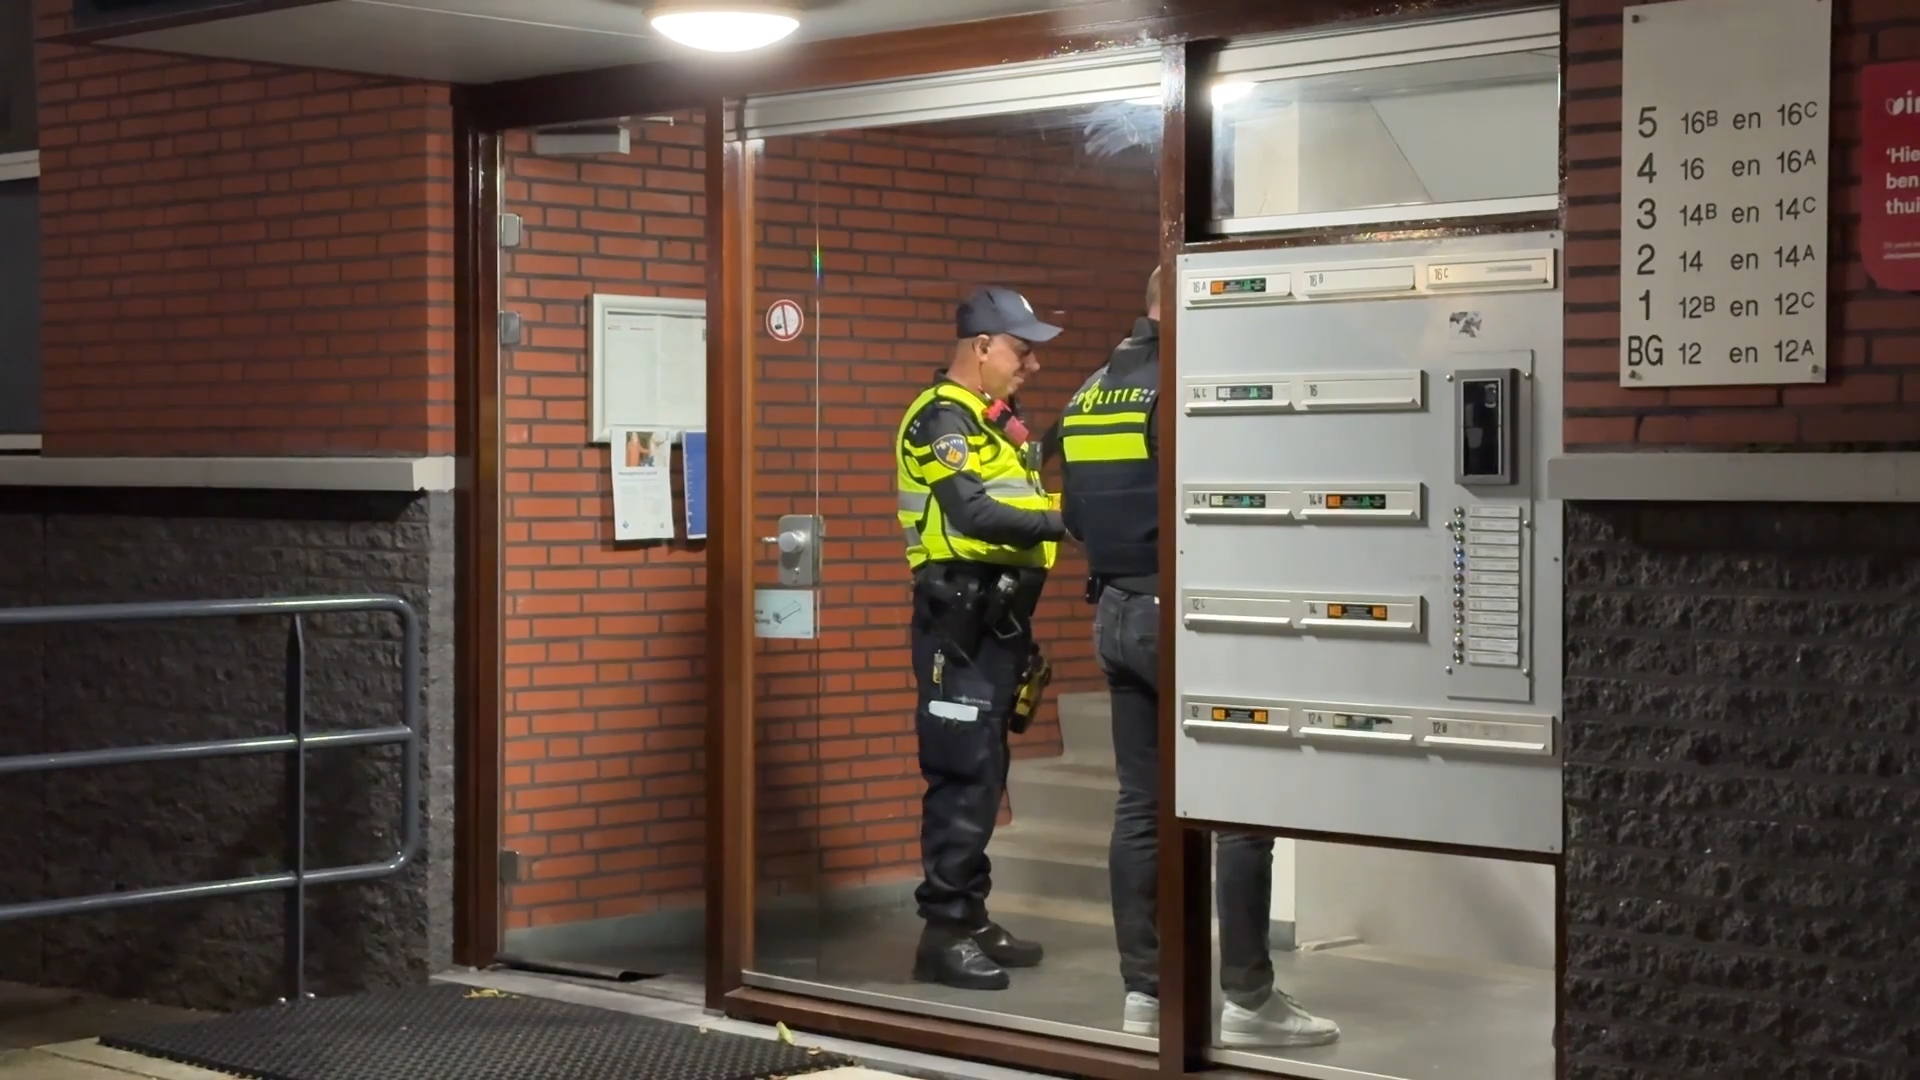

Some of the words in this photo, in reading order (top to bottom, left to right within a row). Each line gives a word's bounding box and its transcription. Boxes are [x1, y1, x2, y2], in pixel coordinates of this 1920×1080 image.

[1638, 106, 1658, 138] 5
[1680, 110, 1719, 135] 16B
[1732, 111, 1762, 130] en
[1776, 101, 1818, 126] 16C
[1636, 152, 1658, 184] 4
[1680, 157, 1705, 181] 16
[1731, 158, 1761, 177] en
[1776, 149, 1817, 174] 16A
[1636, 197, 1657, 230] 3
[1679, 203, 1718, 227] 14B
[1731, 205, 1760, 224] en
[1775, 196, 1817, 221] 14C
[1637, 243, 1655, 276] 2
[1679, 250, 1704, 273] 14
[1730, 252, 1759, 270] en
[1774, 244, 1815, 268] 14A
[1638, 289, 1651, 321] 1
[1679, 295, 1716, 319] 12B
[1730, 299, 1759, 317] en
[1774, 291, 1816, 316] 12C
[1627, 334, 1664, 367] BG
[1678, 342, 1703, 365] 12
[1729, 346, 1759, 363] en
[1774, 339, 1815, 362] 12A
